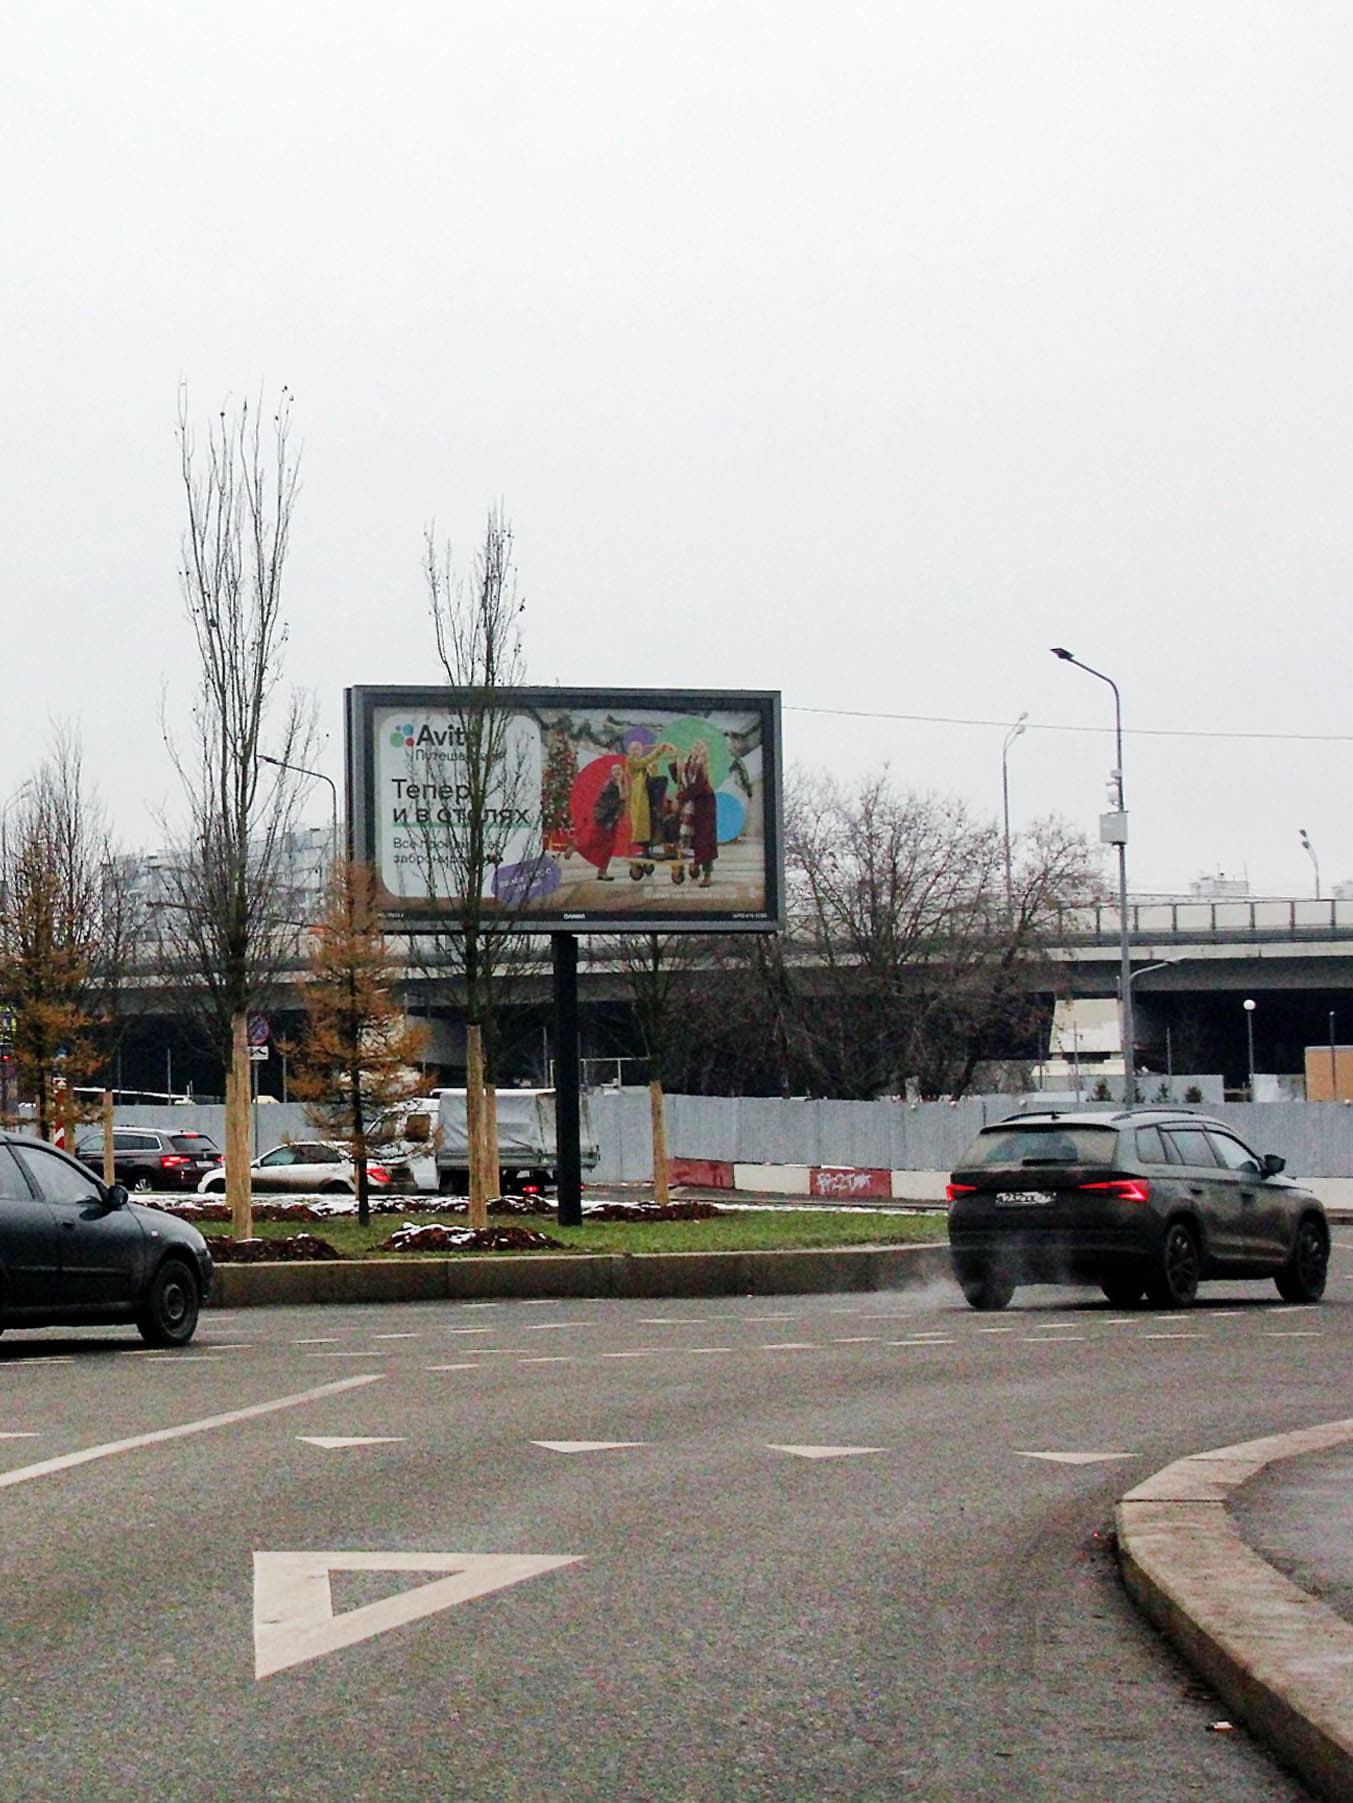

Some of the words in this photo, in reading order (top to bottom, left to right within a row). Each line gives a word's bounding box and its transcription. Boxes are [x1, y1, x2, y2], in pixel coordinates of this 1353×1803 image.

[416, 724, 480, 746] Avit
[391, 778, 481, 805] Тепер
[393, 807, 407, 823] и
[416, 807, 431, 823] в
[436, 807, 530, 824] отлях
